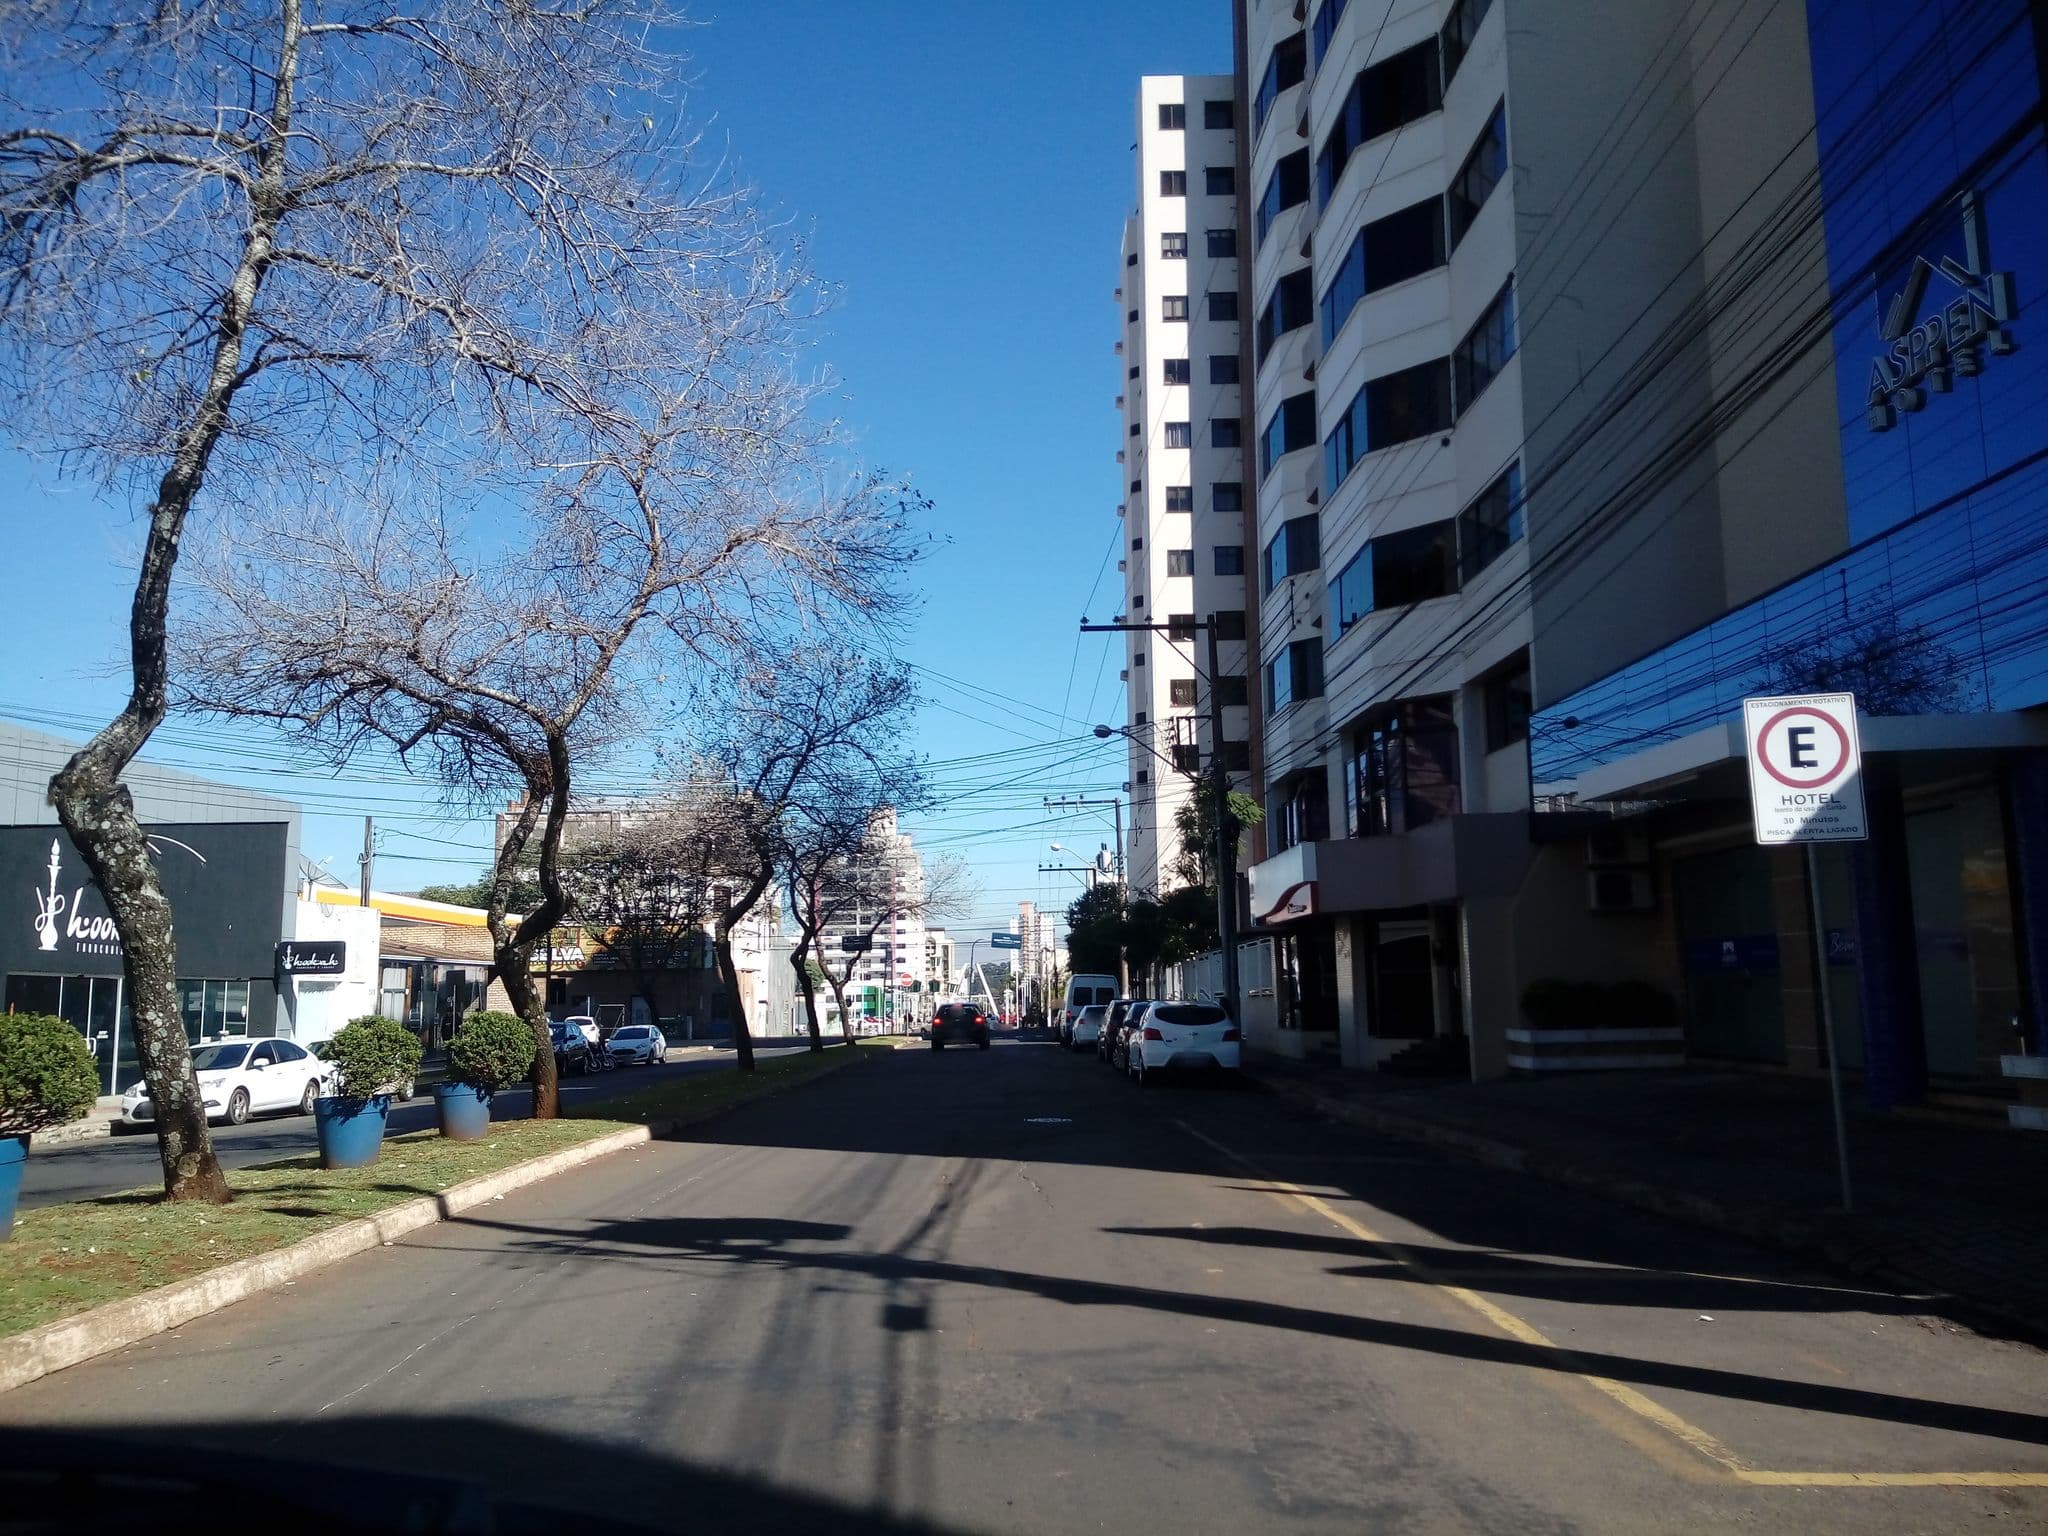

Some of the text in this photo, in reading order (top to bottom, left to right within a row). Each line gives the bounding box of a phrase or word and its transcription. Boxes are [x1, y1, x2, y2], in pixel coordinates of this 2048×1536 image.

[1866, 271, 2012, 406] ASPPEN
[1751, 697, 1846, 708] ESTACIONAMENTO ROTATIVO
[1788, 726, 1818, 768] E
[1782, 793, 1841, 805] HOTEL
[1783, 816, 1839, 825] 30 Minutos
[1793, 828, 1825, 836] ALERTA
[1826, 826, 1858, 834] LIGADO
[293, 953, 339, 967] hookah
[530, 946, 585, 961] SELVA
